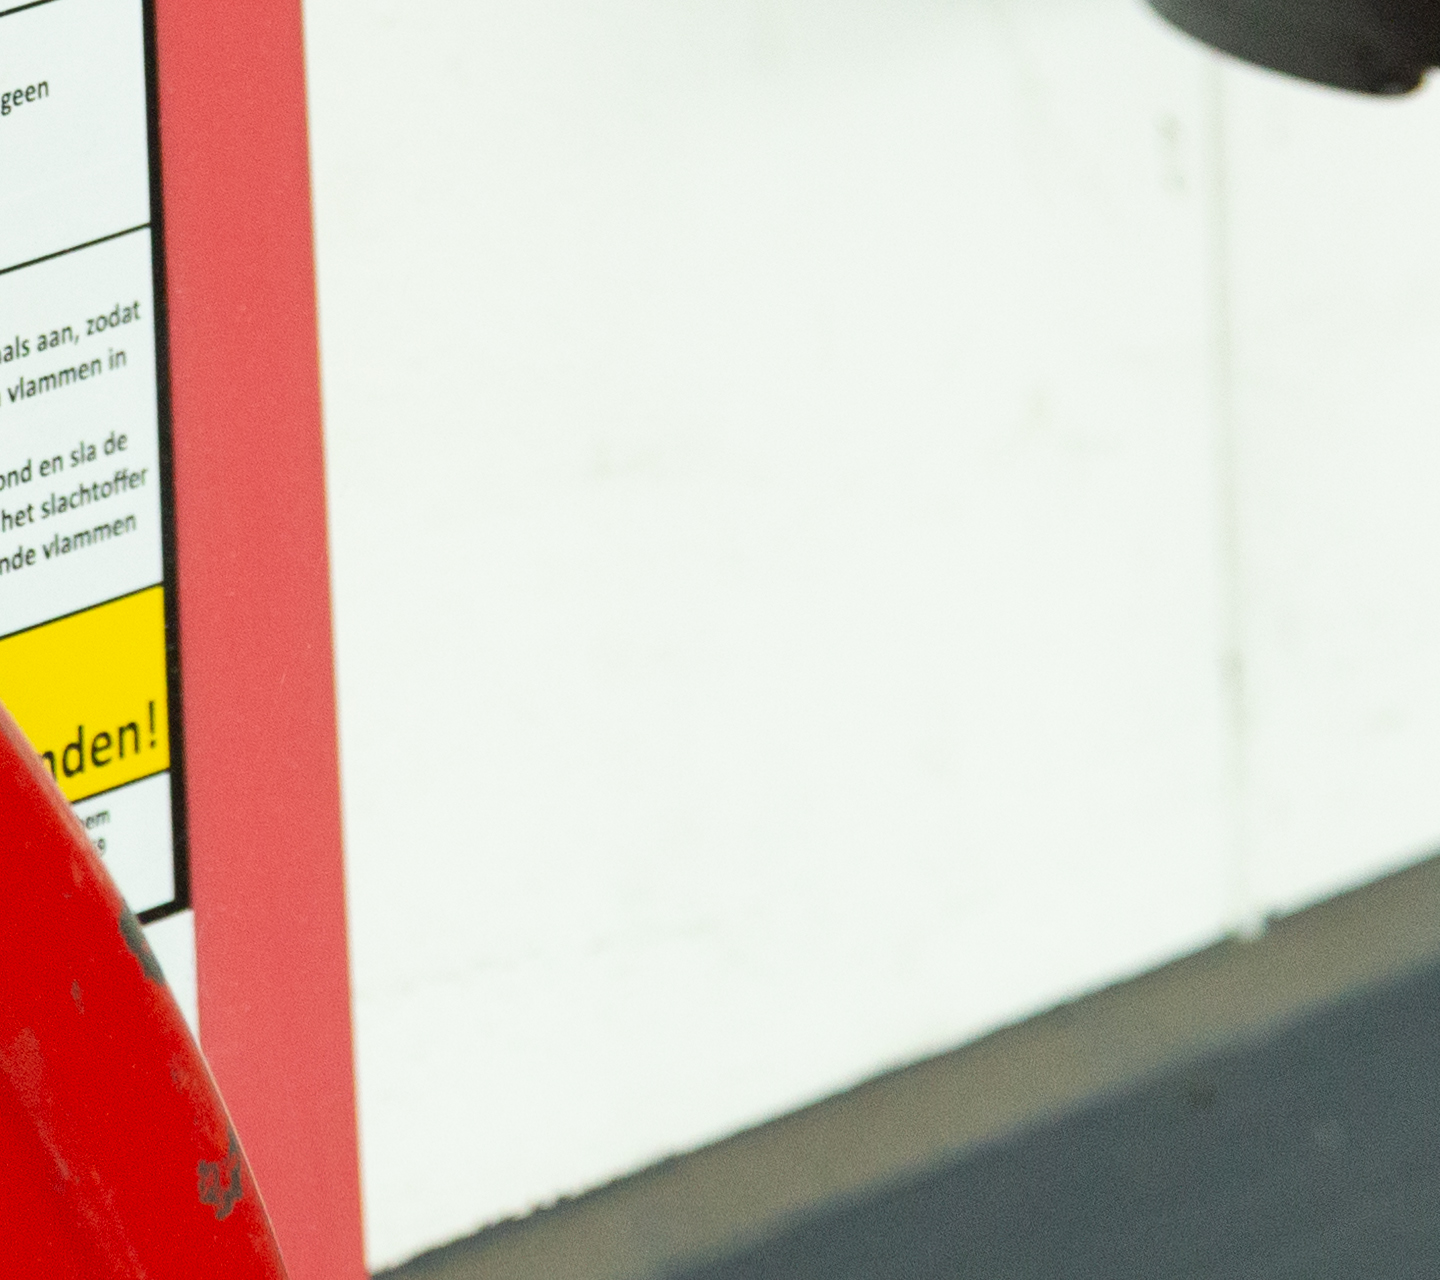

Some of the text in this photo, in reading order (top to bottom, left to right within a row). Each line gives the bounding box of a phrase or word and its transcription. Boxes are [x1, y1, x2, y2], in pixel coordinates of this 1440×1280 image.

[0, 80, 50, 118] geen
[36, 325, 80, 353] aan,
[85, 300, 141, 337] zodat
[6, 358, 102, 404] vlammen
[108, 350, 127, 369] in
[38, 454, 64, 478] en
[70, 441, 97, 468] sla
[103, 431, 128, 457] de
[0, 503, 35, 533] het
[40, 468, 147, 520] slachtoffer
[41, 514, 136, 561] vlammen
